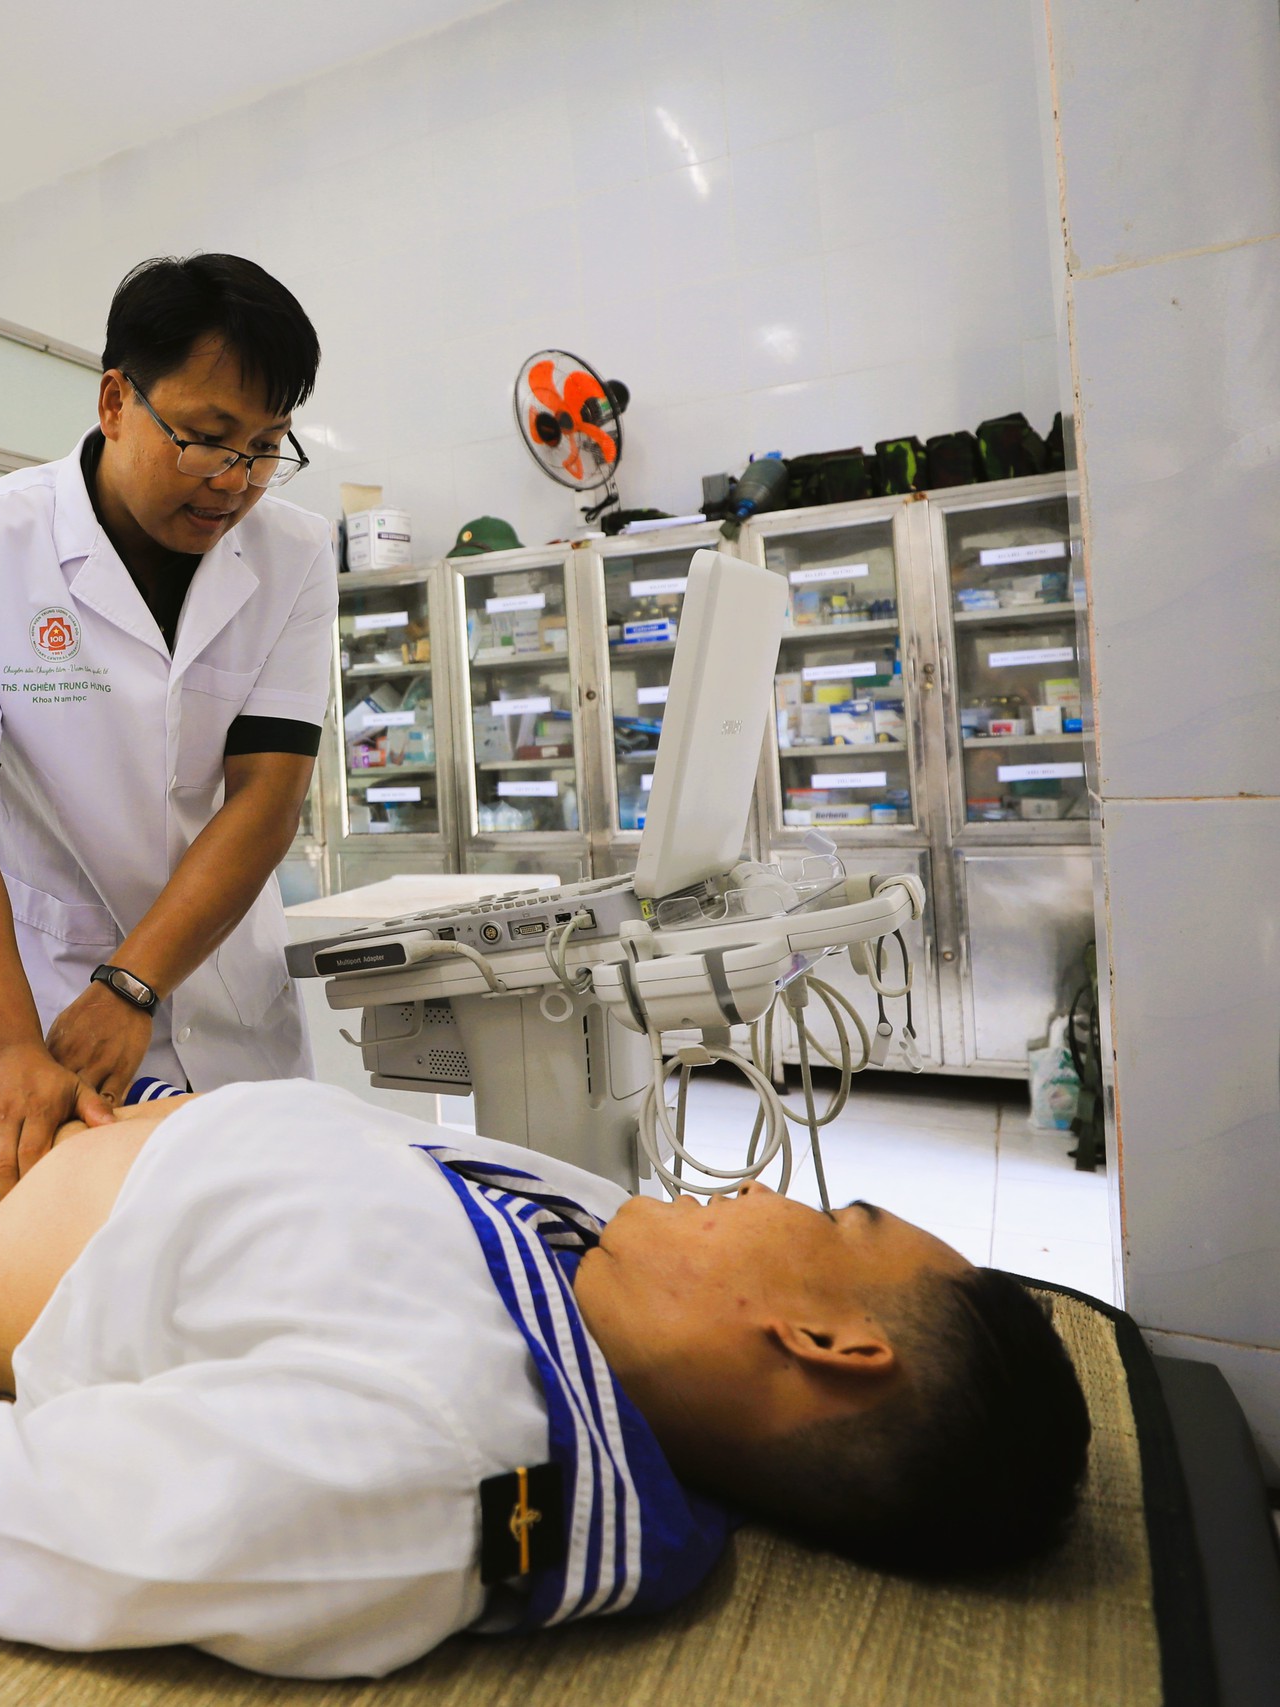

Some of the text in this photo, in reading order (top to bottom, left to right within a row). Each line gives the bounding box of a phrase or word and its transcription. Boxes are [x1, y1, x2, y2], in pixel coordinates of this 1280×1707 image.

[1, 683, 20, 692] ThS.
[23, 682, 56, 692] NGHIÊM
[58, 681, 88, 691] TRUNG
[32, 696, 52, 704] Khoa
[72, 694, 87, 703] học
[336, 955, 384, 966] Multiport Adapter
